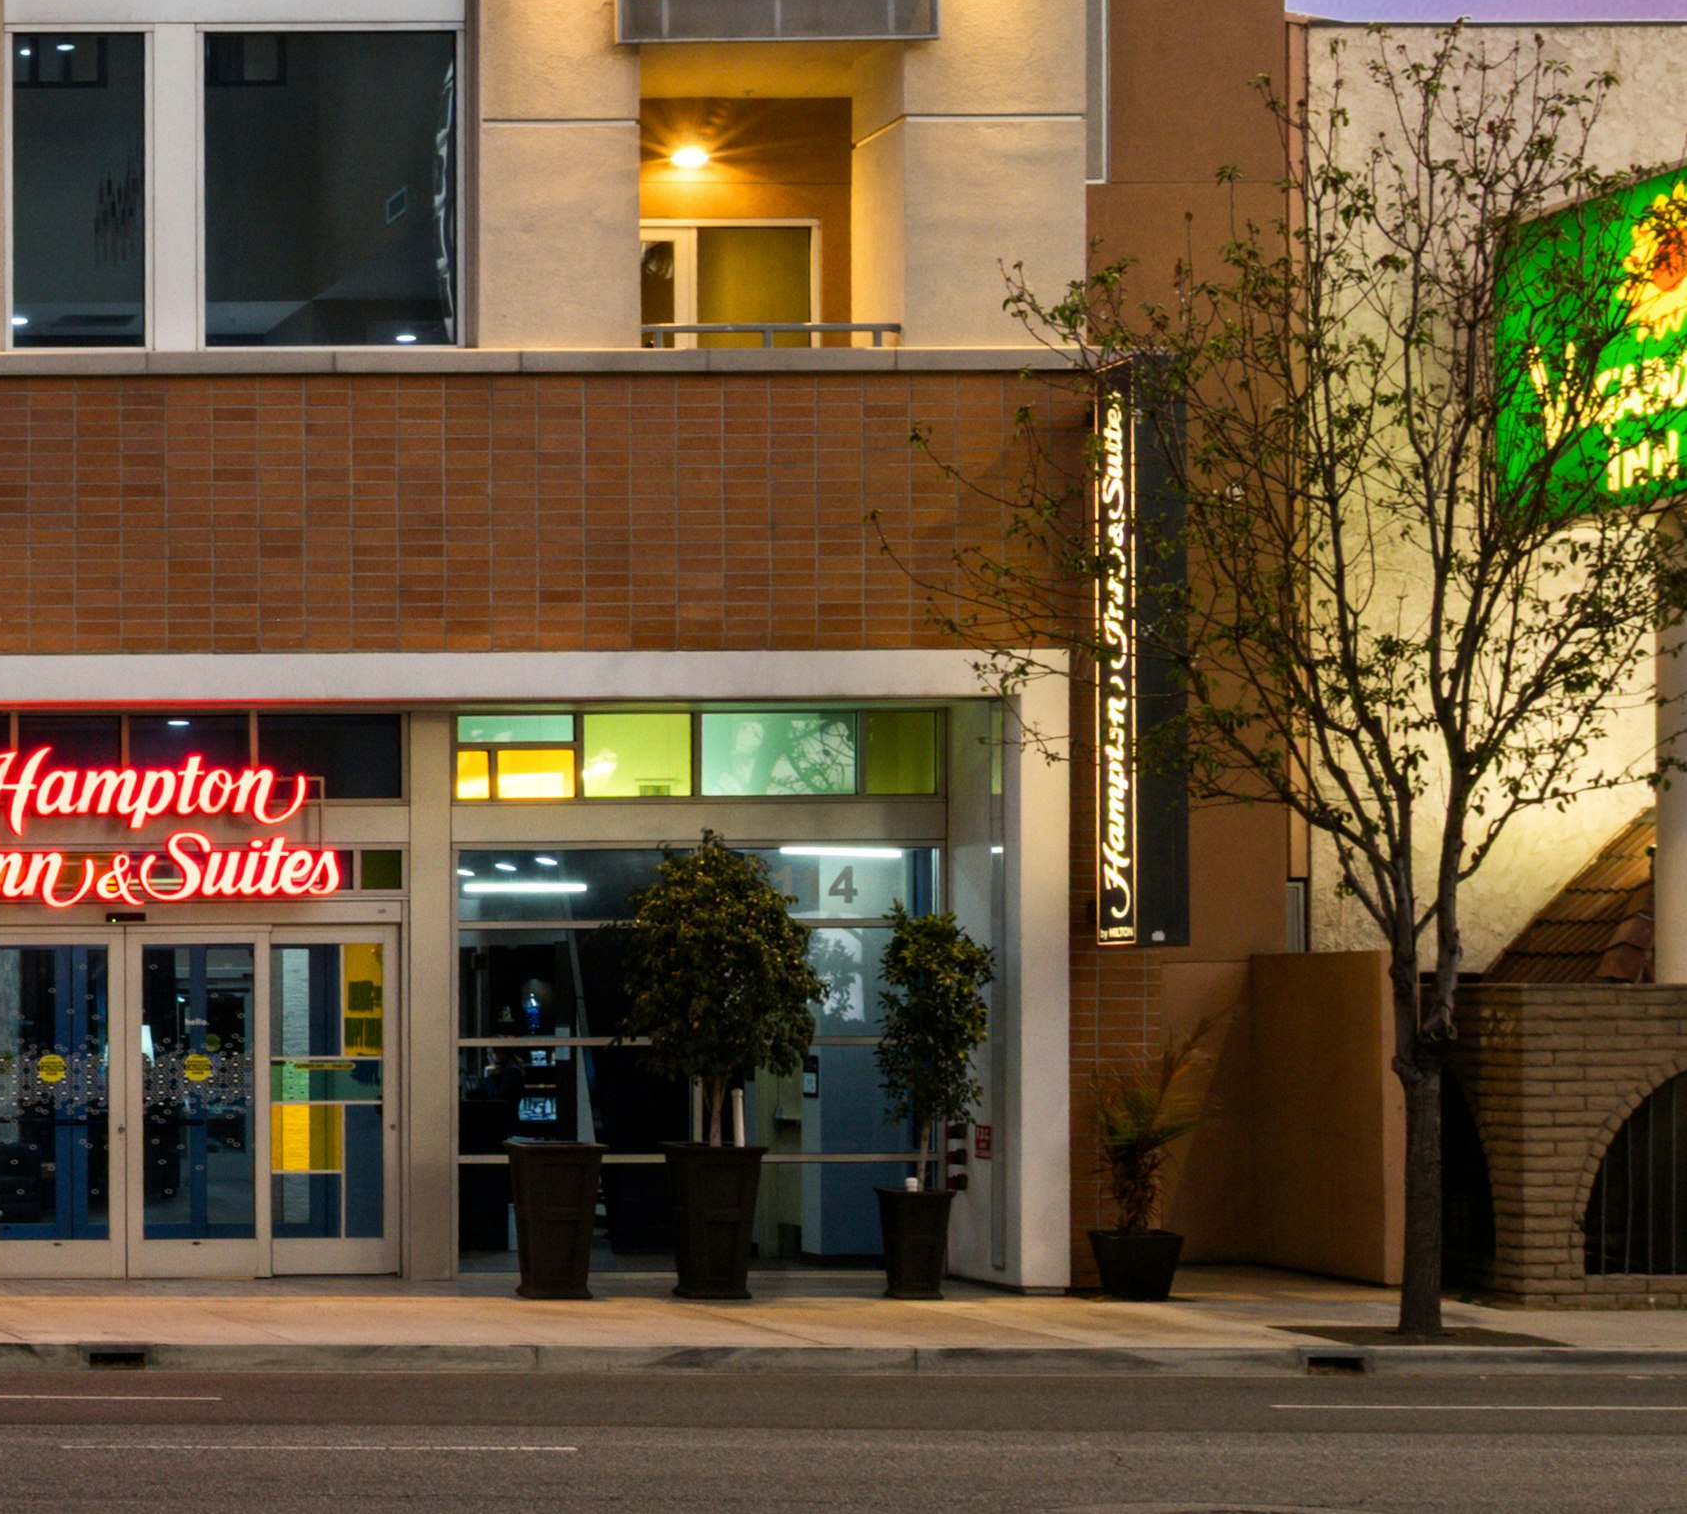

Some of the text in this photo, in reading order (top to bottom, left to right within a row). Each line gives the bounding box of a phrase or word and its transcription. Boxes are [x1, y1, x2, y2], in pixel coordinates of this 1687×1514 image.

[1607, 430, 1679, 492] INN
[1102, 675, 1130, 919] Hampton
[96, 854, 145, 906] &
[141, 832, 340, 903] Suites
[773, 865, 858, 904] 114
[1109, 926, 1134, 938] HILTON
